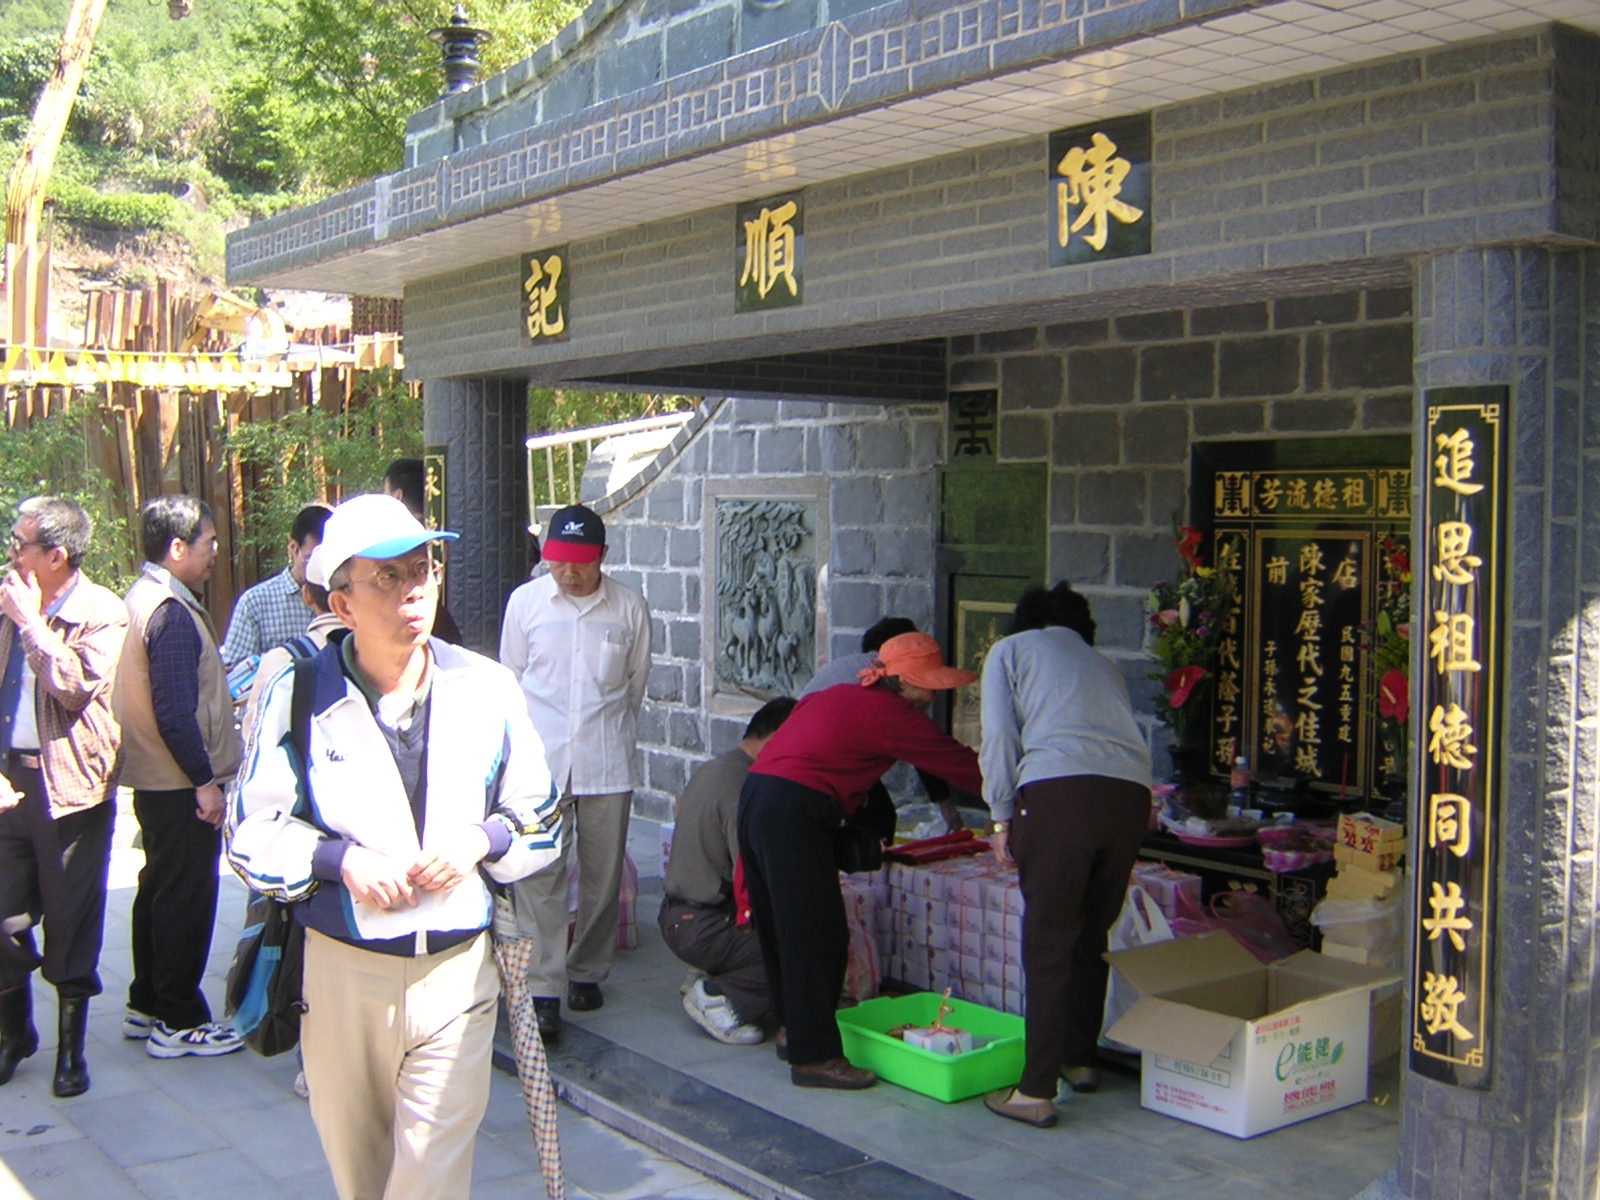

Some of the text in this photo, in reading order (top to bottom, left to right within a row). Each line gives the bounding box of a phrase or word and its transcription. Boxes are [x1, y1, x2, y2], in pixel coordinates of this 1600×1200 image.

[524, 132, 1145, 339] 陳 順 記
[188, 1030, 206, 1043] N
